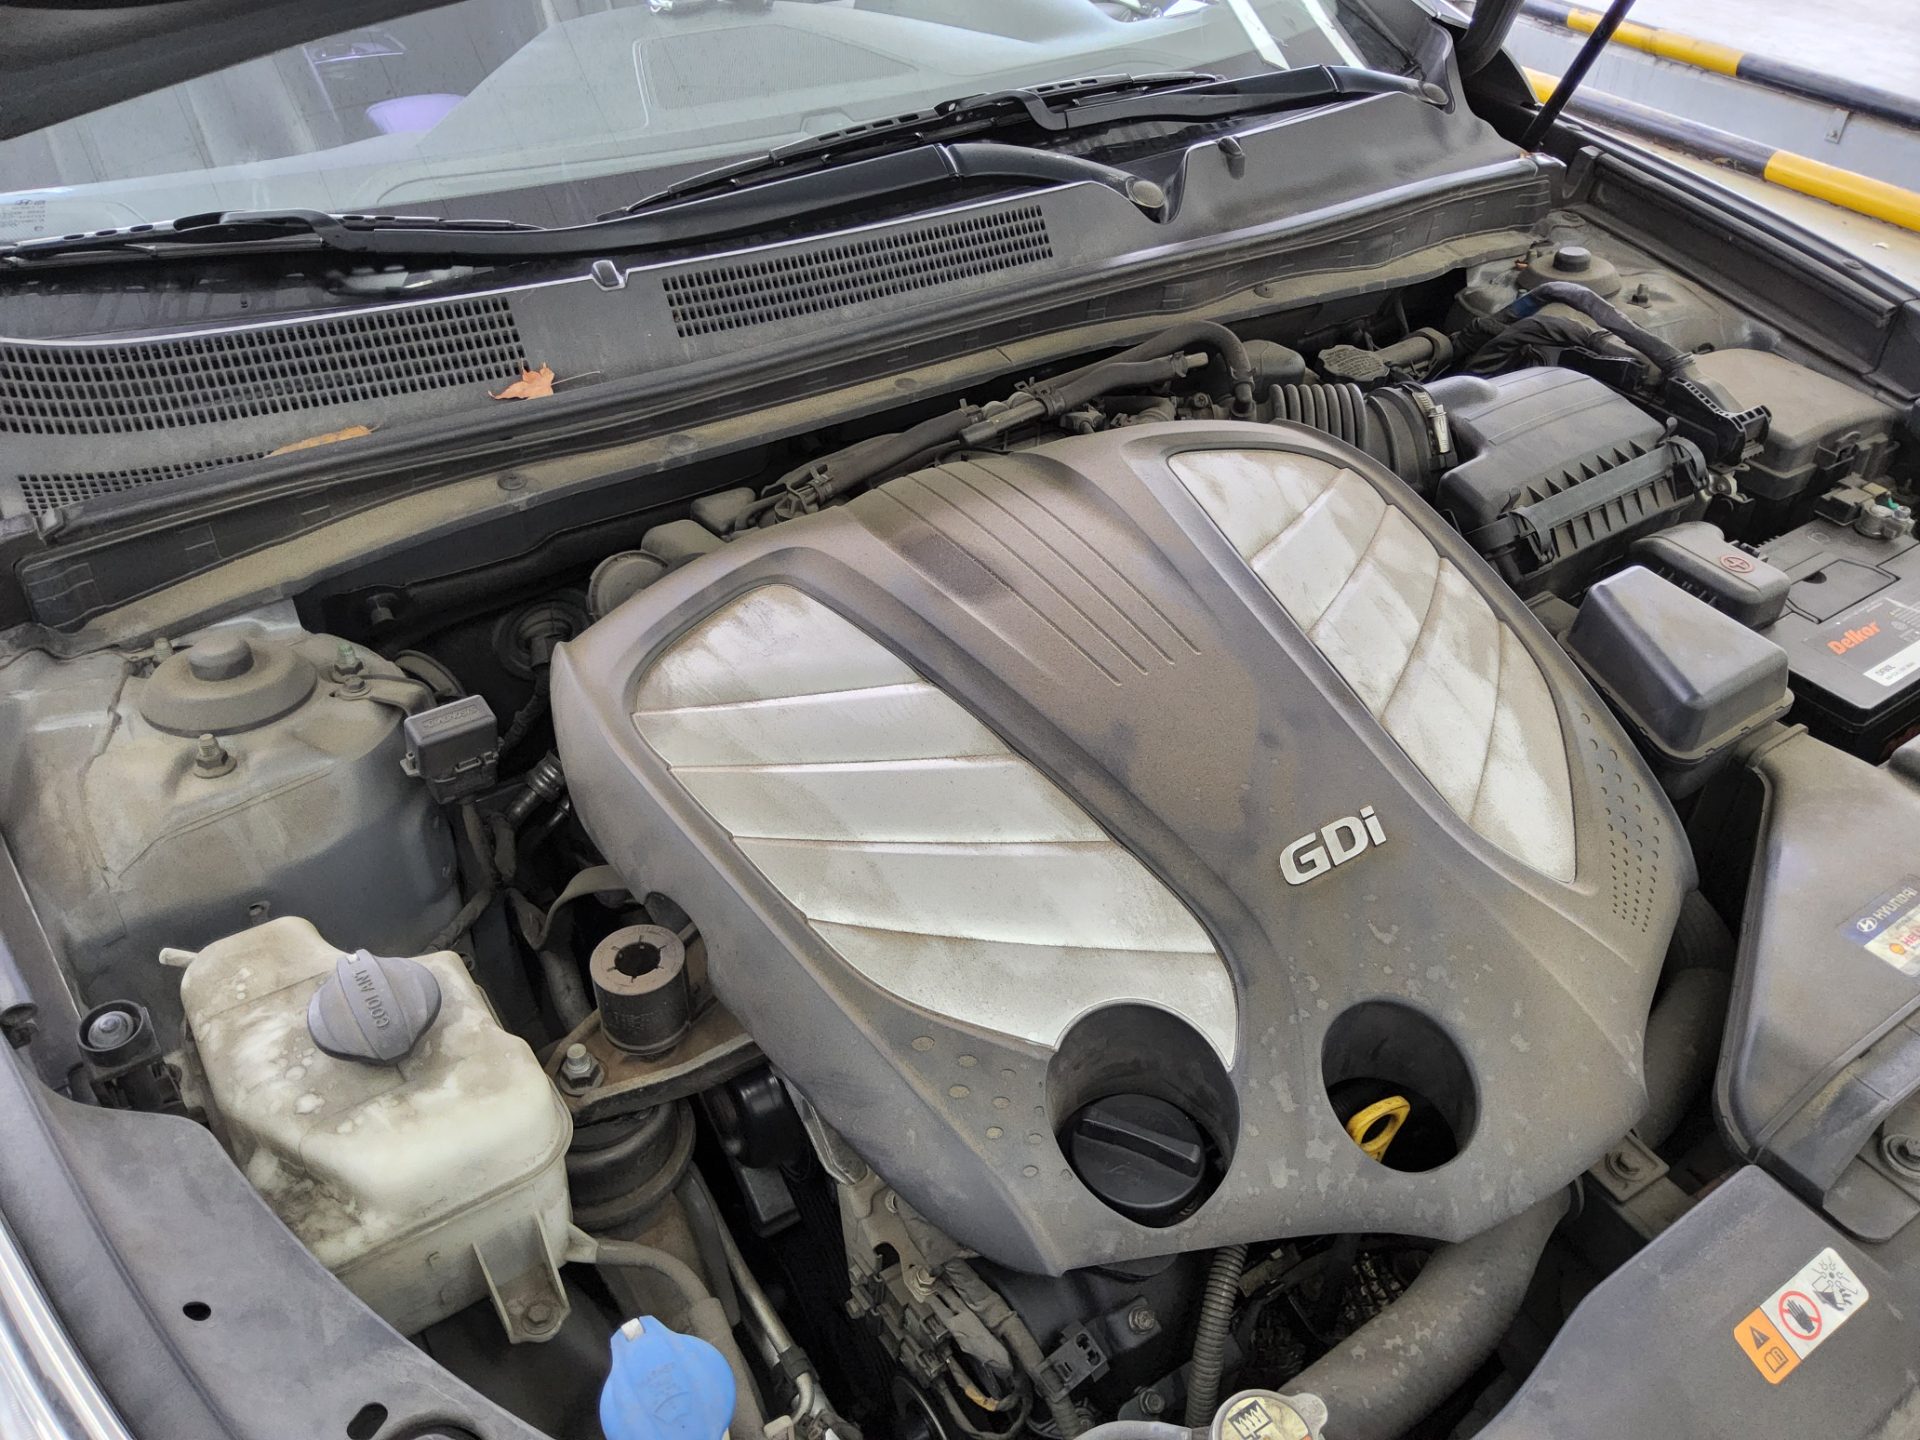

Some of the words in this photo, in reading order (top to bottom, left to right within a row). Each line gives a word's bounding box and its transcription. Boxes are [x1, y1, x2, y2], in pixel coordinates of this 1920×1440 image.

[1826, 620, 1880, 655] Delkor
[1280, 805, 1387, 885] GDi
[1872, 886, 1919, 921] HYUNDAI
